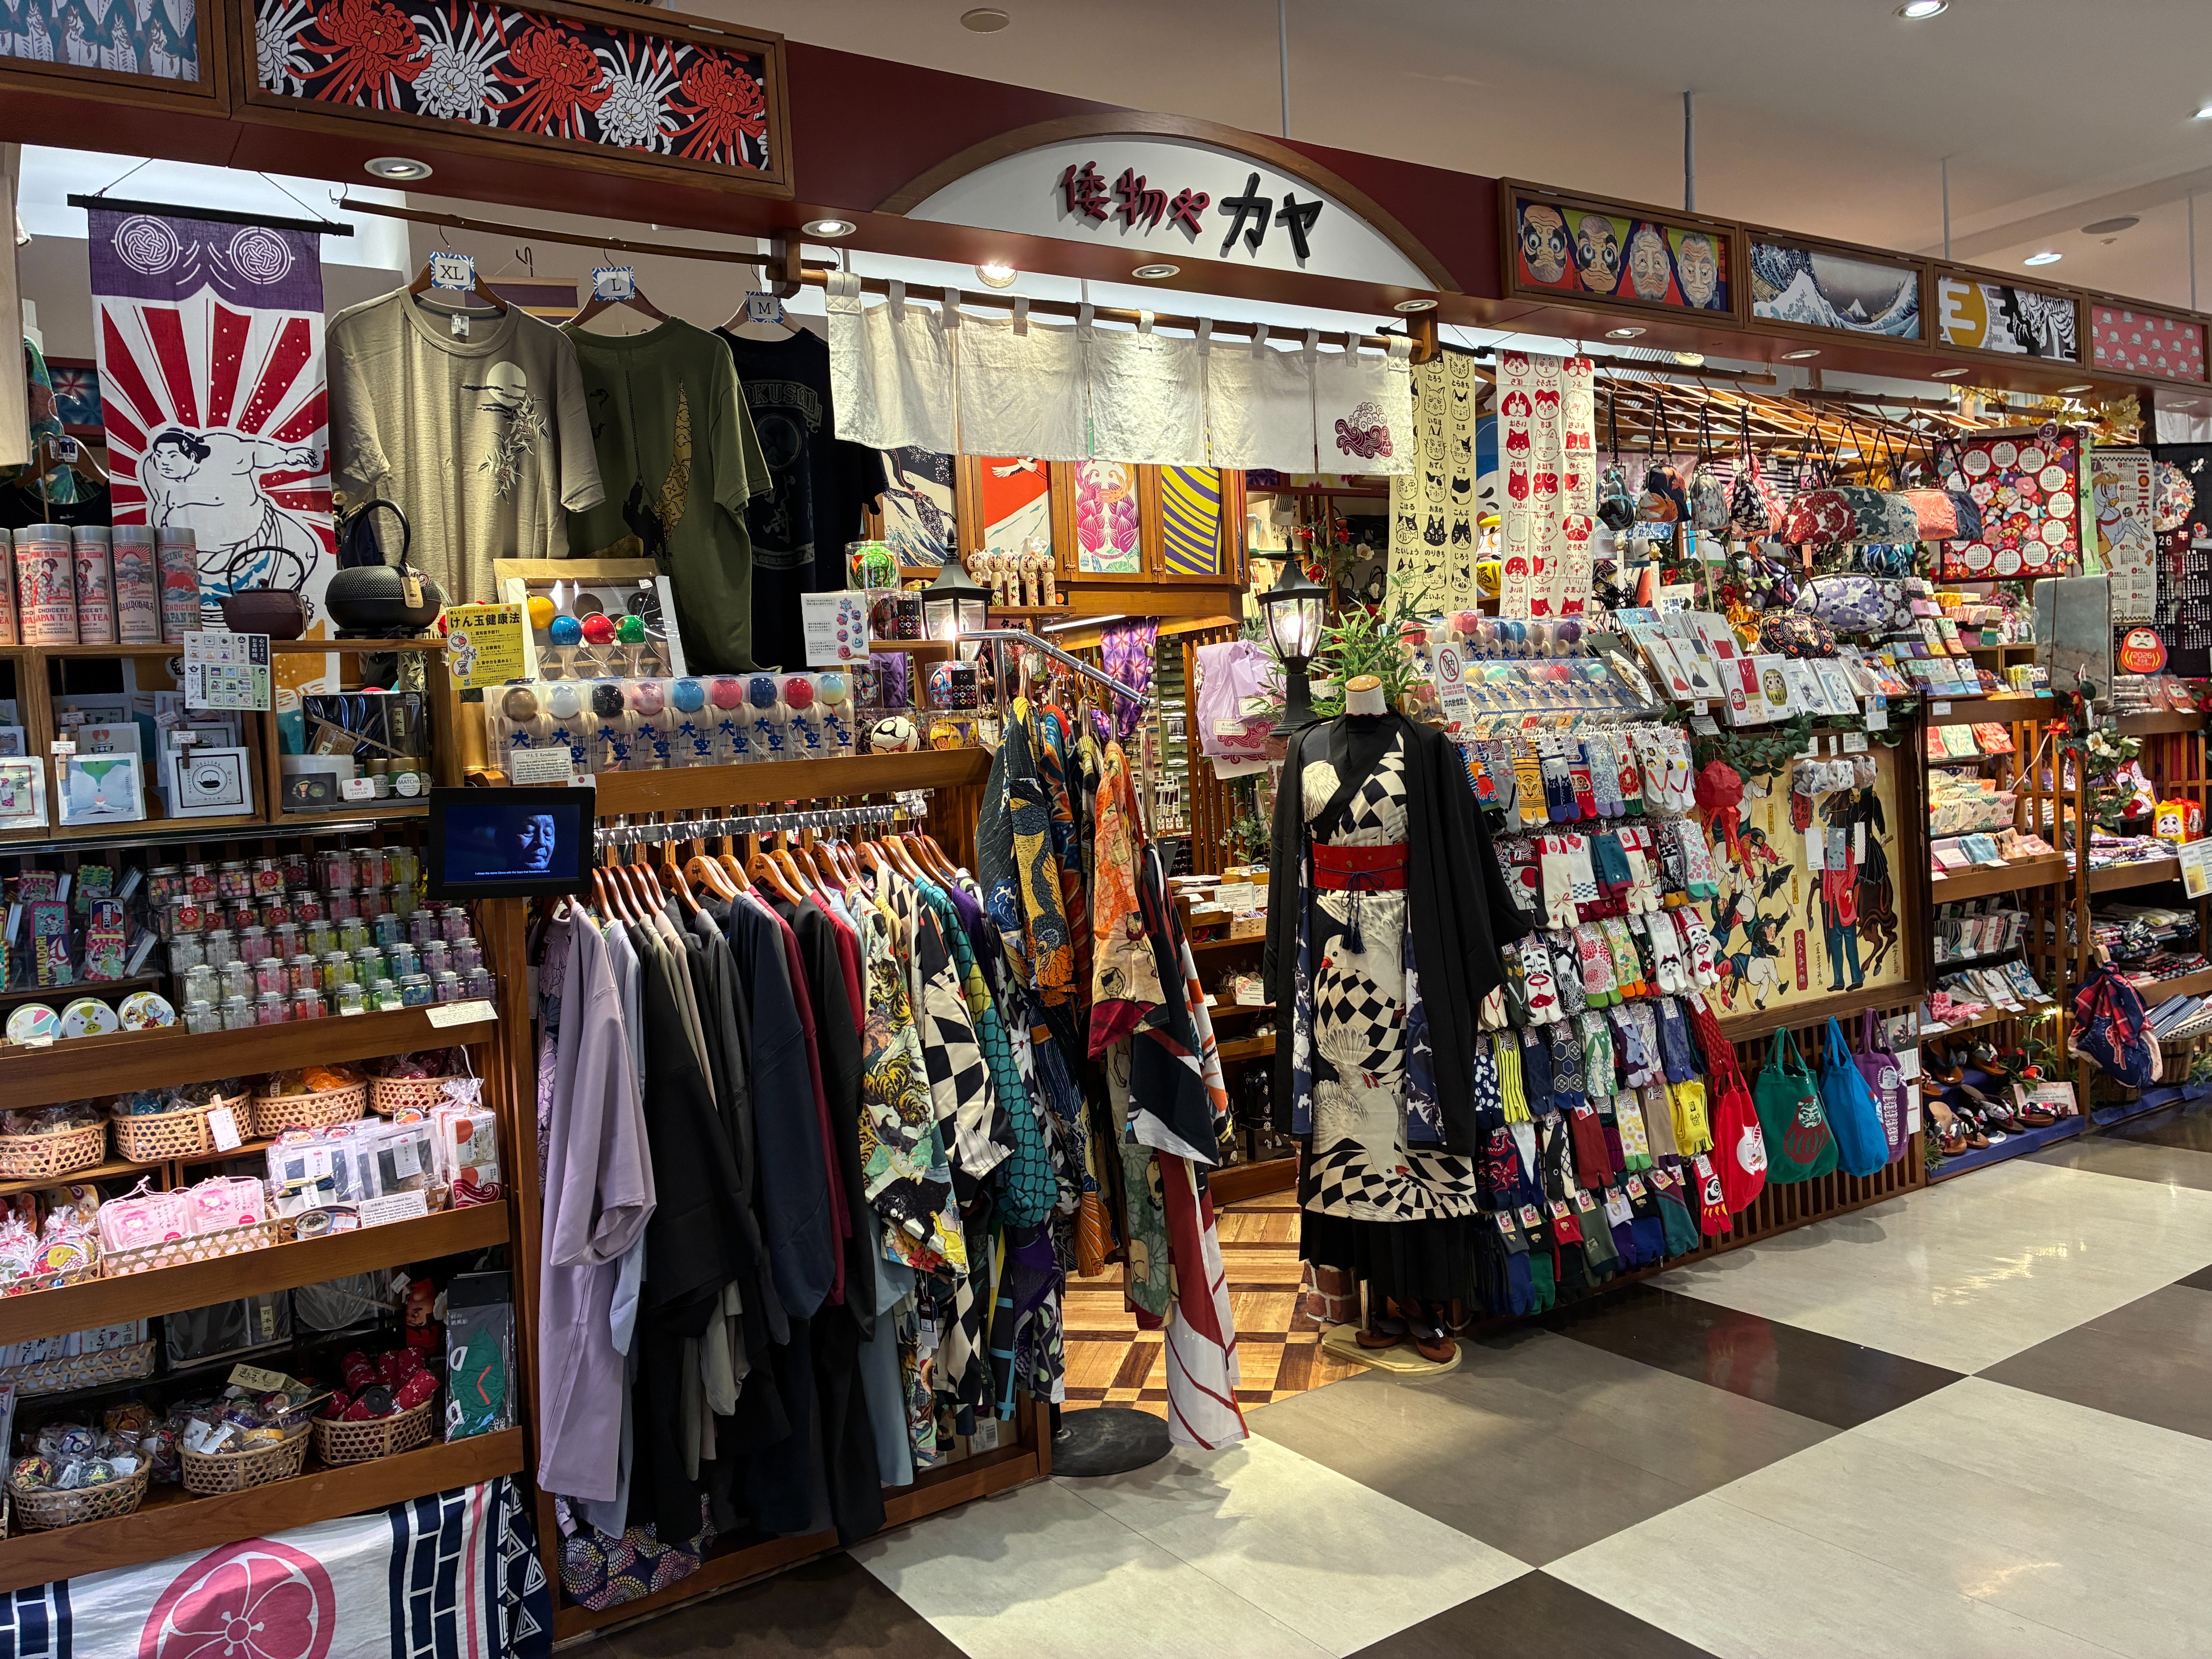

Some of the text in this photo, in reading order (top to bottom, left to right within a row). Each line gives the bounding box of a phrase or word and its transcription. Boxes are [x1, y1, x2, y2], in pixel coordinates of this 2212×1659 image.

[1060, 161, 1323, 259] 倭物やカヤ
[440, 265, 464, 280] XL
[612, 279, 621, 291] L
[758, 302, 771, 314] M
[1428, 374, 1441, 383] たろう
[1452, 379, 1470, 389] とらきち
[741, 384, 818, 413] OKUSAI
[1428, 417, 1442, 426] いなほ
[2044, 426, 2053, 436] 5
[2080, 428, 2085, 438] 6
[1429, 461, 1443, 470] おでん
[1456, 466, 1466, 474] ごま
[2092, 460, 2097, 470] 7
[1400, 503, 1415, 511] こはる
[1429, 505, 1443, 514] おまめ
[1395, 547, 1419, 556] たいしょう
[1425, 550, 1445, 558] のりきち
[1455, 553, 1469, 561] じろう
[93, 613, 108, 622] TEA
[188, 613, 201, 623] TEA
[450, 612, 520, 628] けん玉健康法
[1444, 697, 1467, 708] 店内飲食禁止
[718, 719, 749, 753] 大空
[754, 716, 784, 751] 大空
[791, 715, 821, 749] 大空
[823, 713, 853, 747] 大空
[511, 730, 531, 748] 大
[598, 725, 631, 760] 大空
[637, 723, 671, 759] 大空
[679, 721, 711, 756] 大空
[551, 727, 587, 764] 大空
[15, 771, 25, 790] 玉露
[35, 935, 49, 986] KUMADORI
